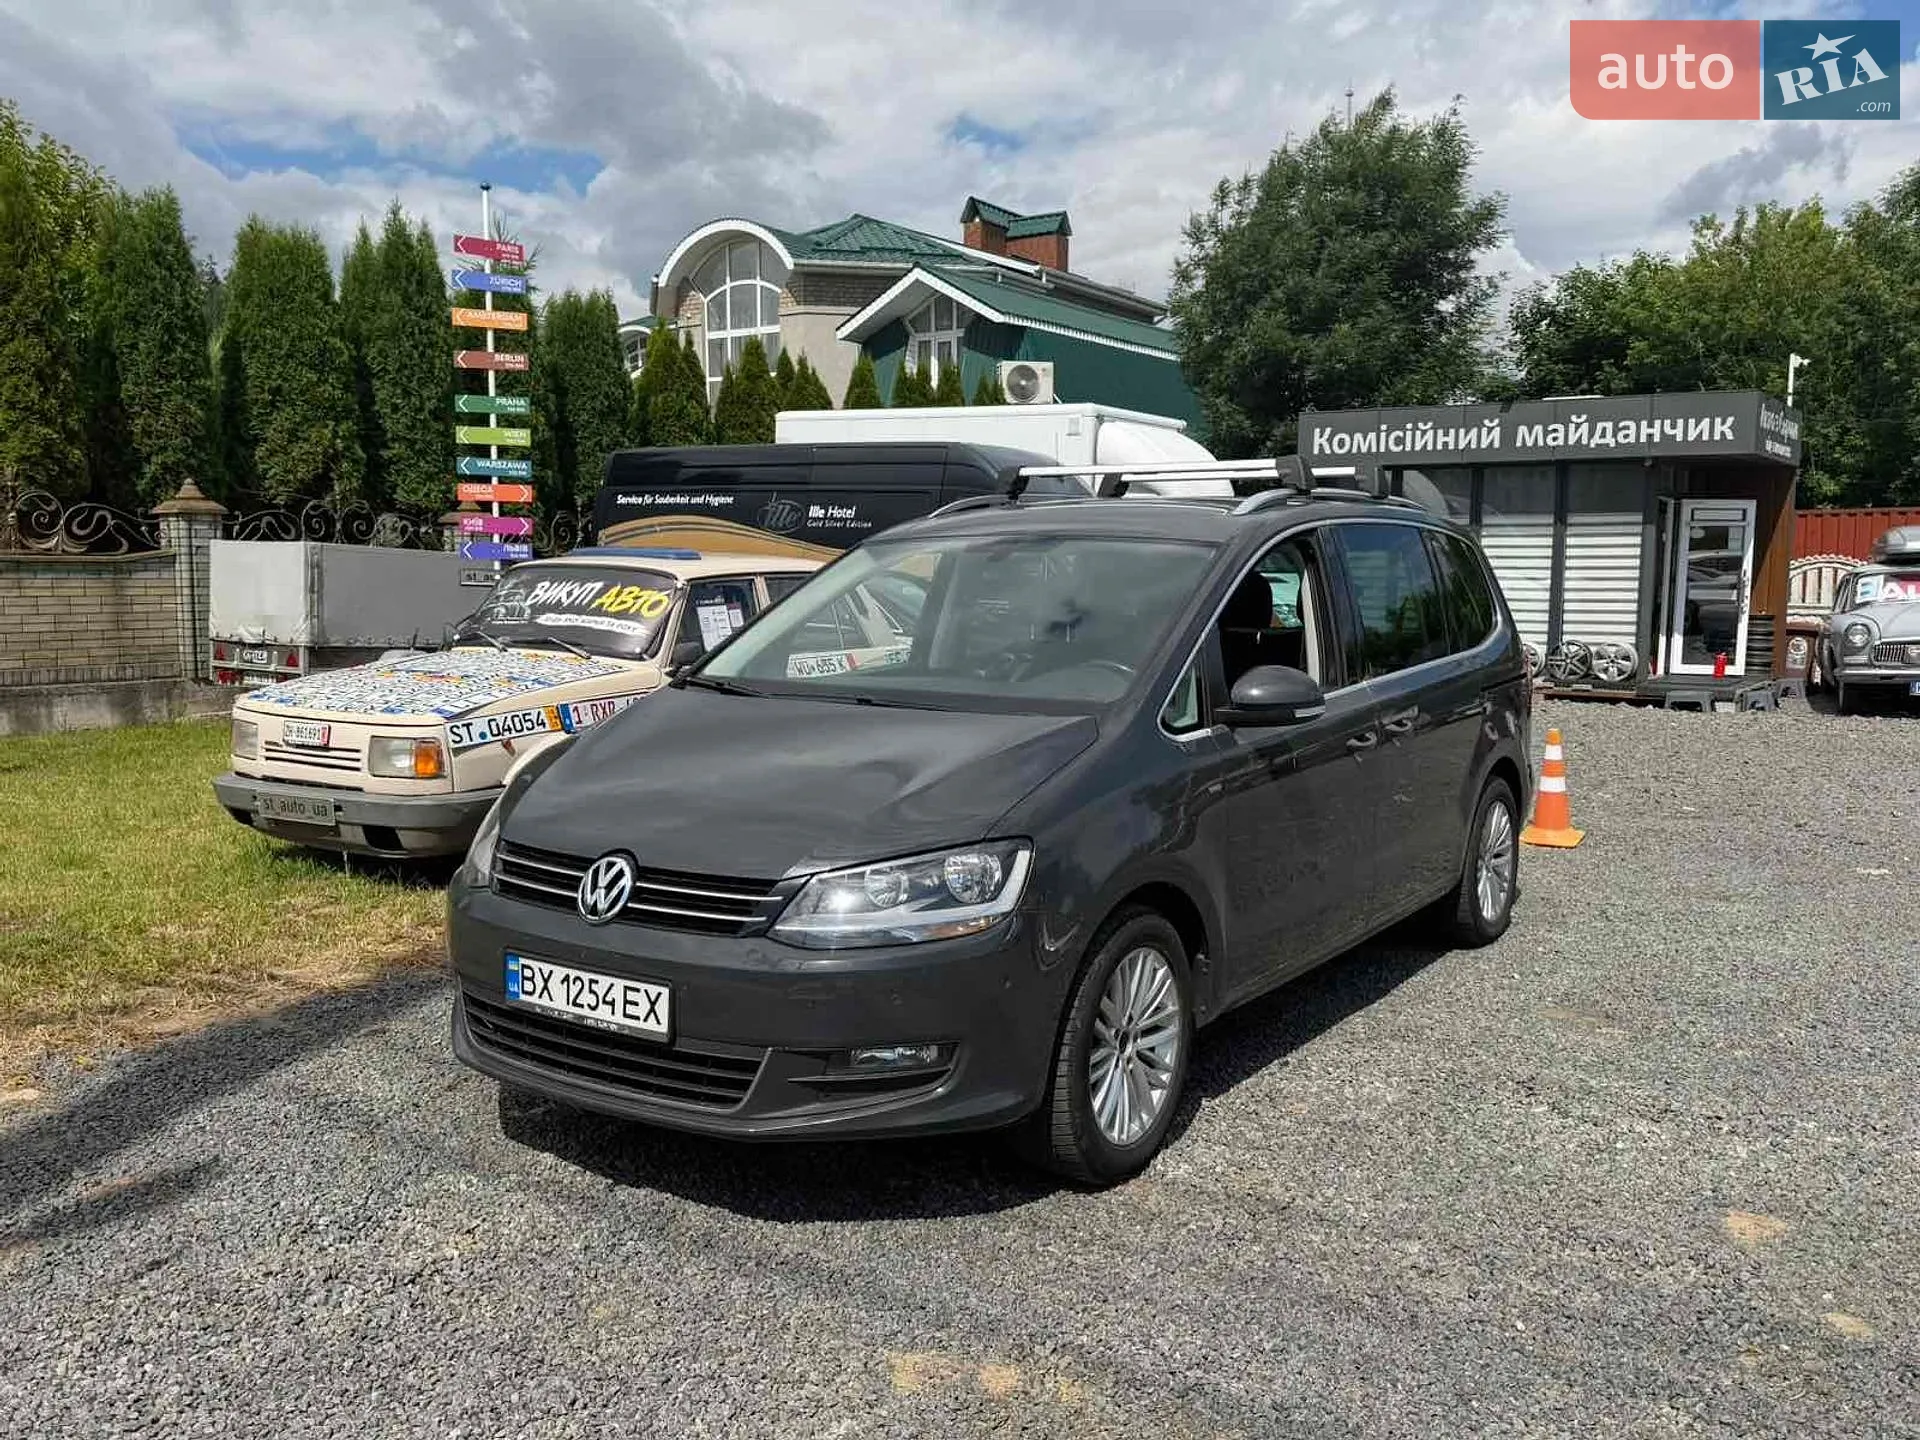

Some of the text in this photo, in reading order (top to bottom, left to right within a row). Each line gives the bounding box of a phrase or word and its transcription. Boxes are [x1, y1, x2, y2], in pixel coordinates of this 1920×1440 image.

[496, 398, 526, 406] PRAHA
[1313, 418, 1501, 454] Комісійний
[1515, 414, 1735, 448] майданчик
[475, 459, 528, 469] WARSZAWA
[616, 493, 643, 505] Service
[690, 494, 705, 505] und
[704, 493, 734, 507] Hygiene
[826, 505, 857, 519] Hotel
[806, 519, 824, 528] Gold
[846, 519, 873, 529] Edition
[526, 580, 671, 619] ВИКУП АВТО
[520, 963, 663, 1026] BX 1254 EX
